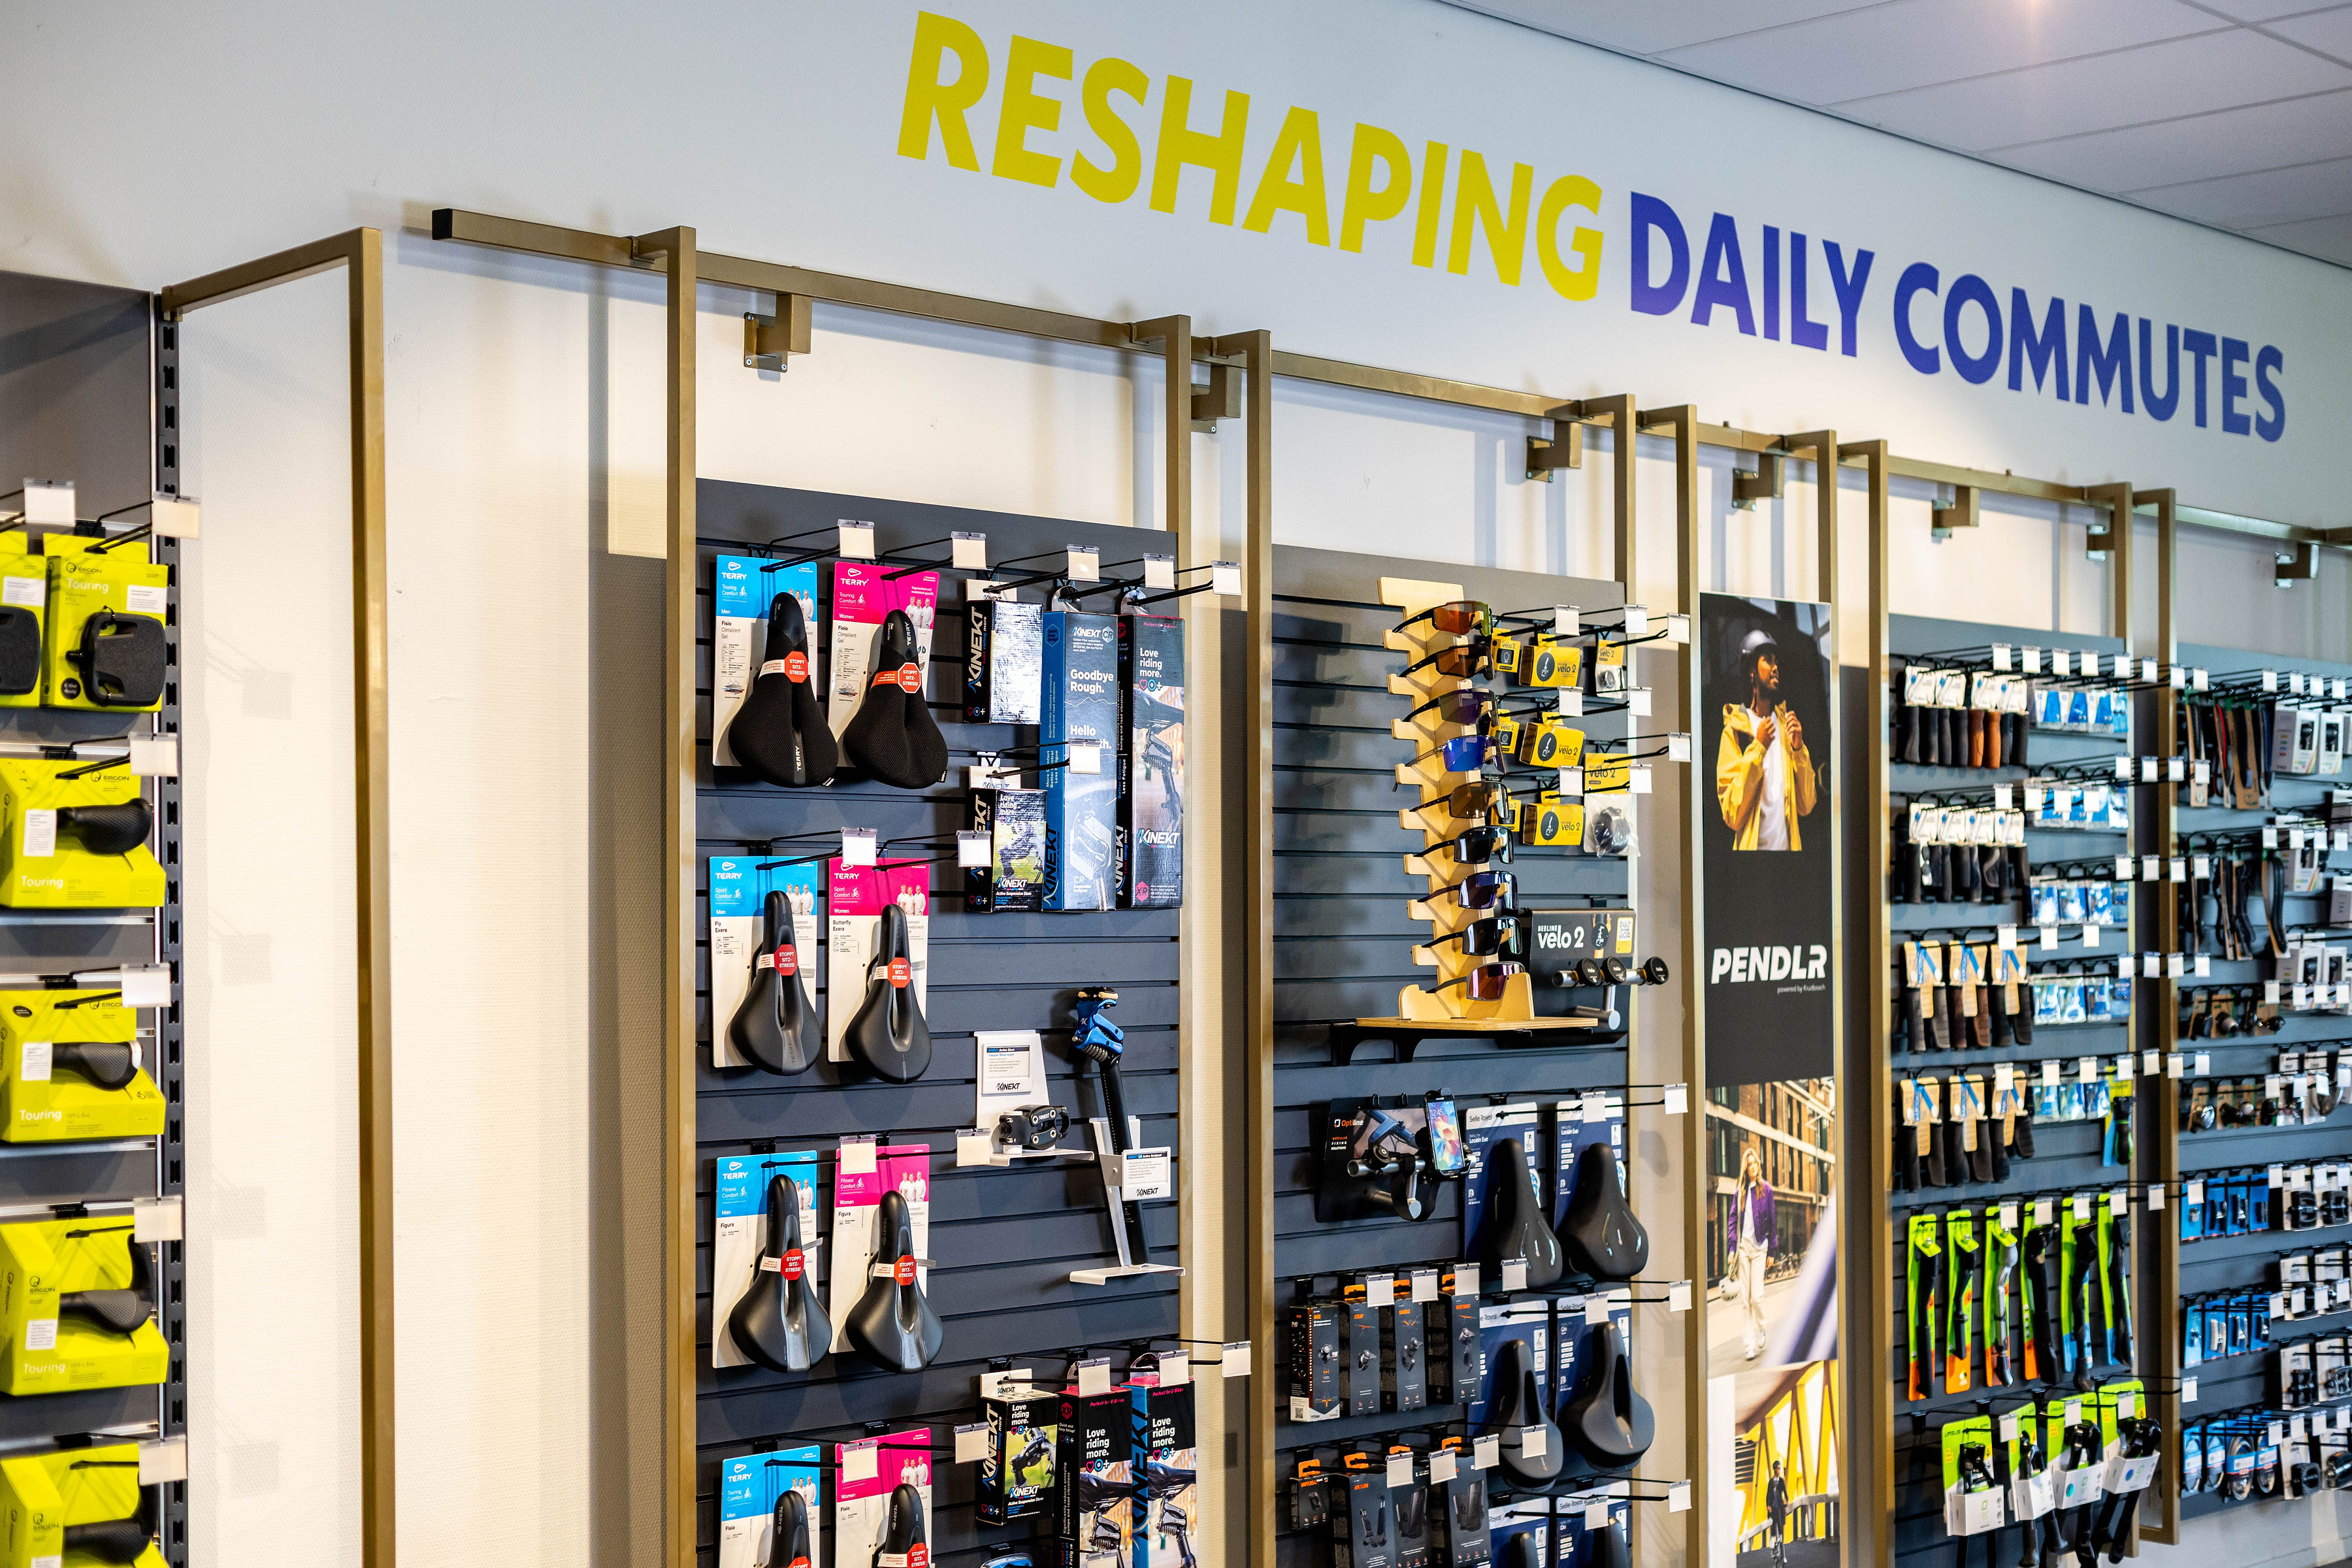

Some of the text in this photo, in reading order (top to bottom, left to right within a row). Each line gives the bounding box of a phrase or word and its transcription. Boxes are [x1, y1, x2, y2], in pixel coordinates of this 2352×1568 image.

[897, 10, 2285, 442] RESHAPING DAILY COMMUTES
[67, 578, 108, 594] Touring
[1073, 627, 1102, 638] KINEKT
[968, 606, 983, 687] KINEKT
[1139, 647, 1158, 657] Love
[1139, 659, 1162, 670] riding
[1558, 663, 1576, 673] velo 2
[1070, 669, 1114, 683] Goodbye
[1139, 668, 1162, 678] more.
[1070, 681, 1104, 694] Rough.
[1070, 725, 1096, 736] Hello
[1559, 747, 1573, 755] velo
[1561, 822, 1575, 830] velo
[1137, 828, 1181, 846] KINEKT
[21, 875, 63, 890] Touring
[997, 877, 1028, 889] KINEKT
[1136, 887, 1148, 896] XR
[1538, 925, 1584, 949] velo 2
[1711, 944, 1827, 984] PENDLR
[1777, 987, 1796, 995] powered
[996, 1083, 1021, 1091] KINEKT
[20, 1109, 61, 1121] Touring
[1341, 1119, 1364, 1128] Optiline
[1135, 1188, 1159, 1197] KINEKT
[24, 1363, 65, 1374] Touring
[1062, 1406, 1072, 1415] XR
[1152, 1416, 1171, 1428] Love
[1086, 1428, 1105, 1439] Love
[1152, 1427, 1175, 1438] riding
[983, 1403, 998, 1486] KINEKT
[1086, 1438, 1109, 1449] riding
[1152, 1437, 1175, 1448] more.
[1086, 1448, 1109, 1459] more.
[728, 1473, 752, 1483] TERRY
[1009, 1485, 1040, 1499] KINEKT
